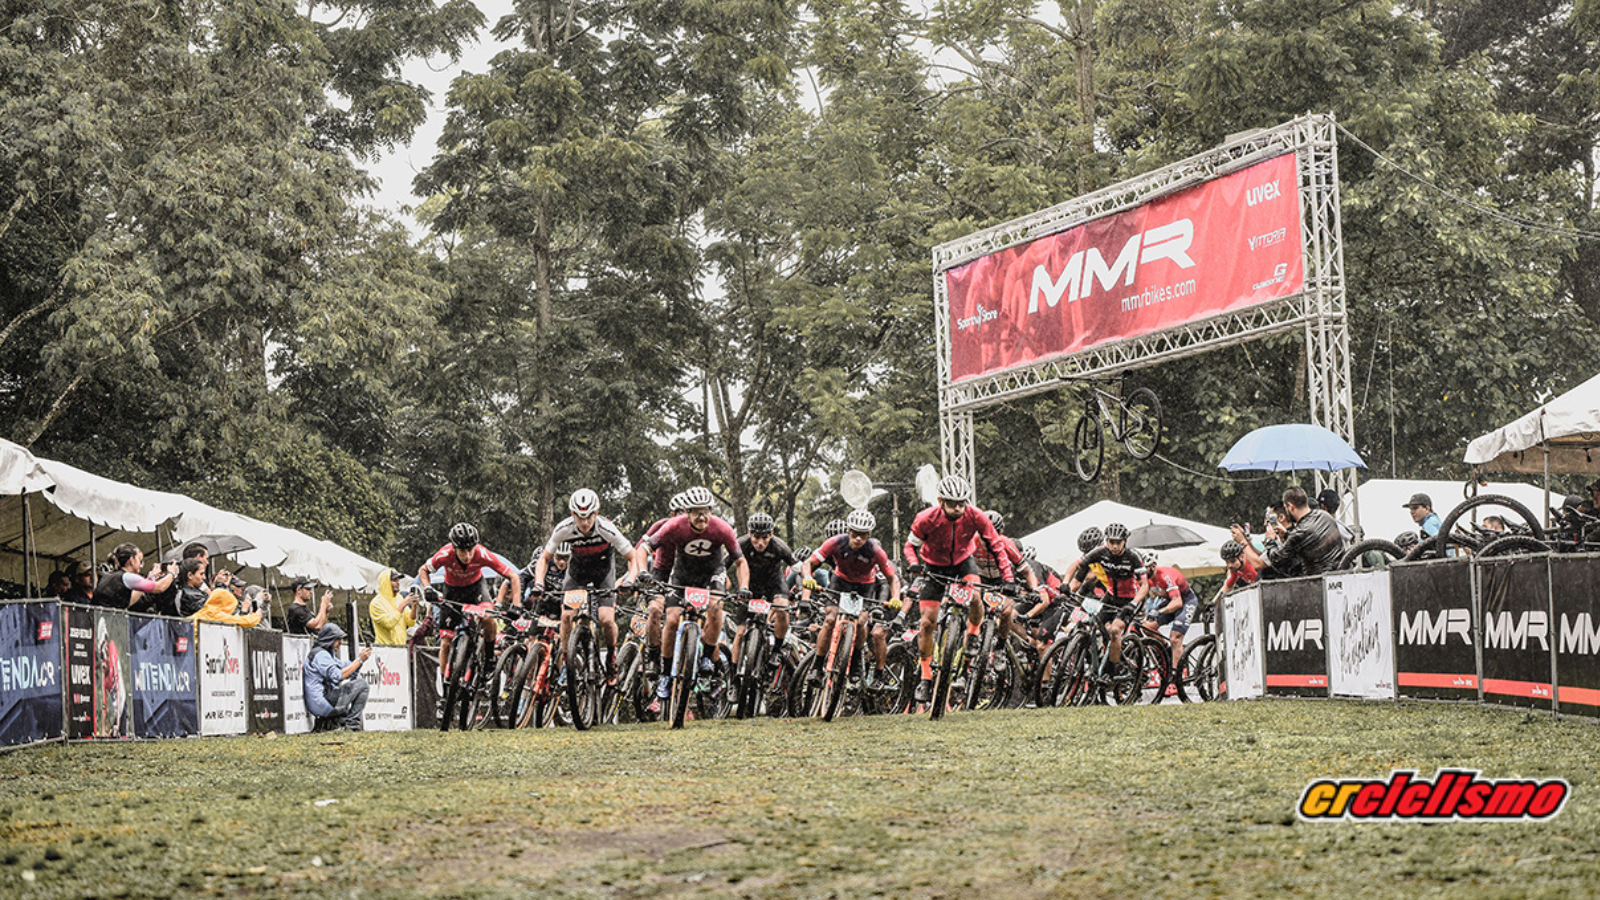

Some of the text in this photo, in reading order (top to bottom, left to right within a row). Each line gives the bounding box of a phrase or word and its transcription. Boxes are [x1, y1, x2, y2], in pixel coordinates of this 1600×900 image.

[1246, 179, 1281, 207] uvex
[1028, 217, 1196, 314] MMR
[1121, 279, 1196, 313] mmrbikes.com
[953, 586, 970, 600] 505
[1267, 618, 1325, 651] MMR
[1399, 608, 1473, 645] MMR
[1484, 610, 1550, 651] MMR
[1559, 612, 1600, 655] MM
[253, 650, 278, 690] uvex
[382, 666, 401, 685] Store
